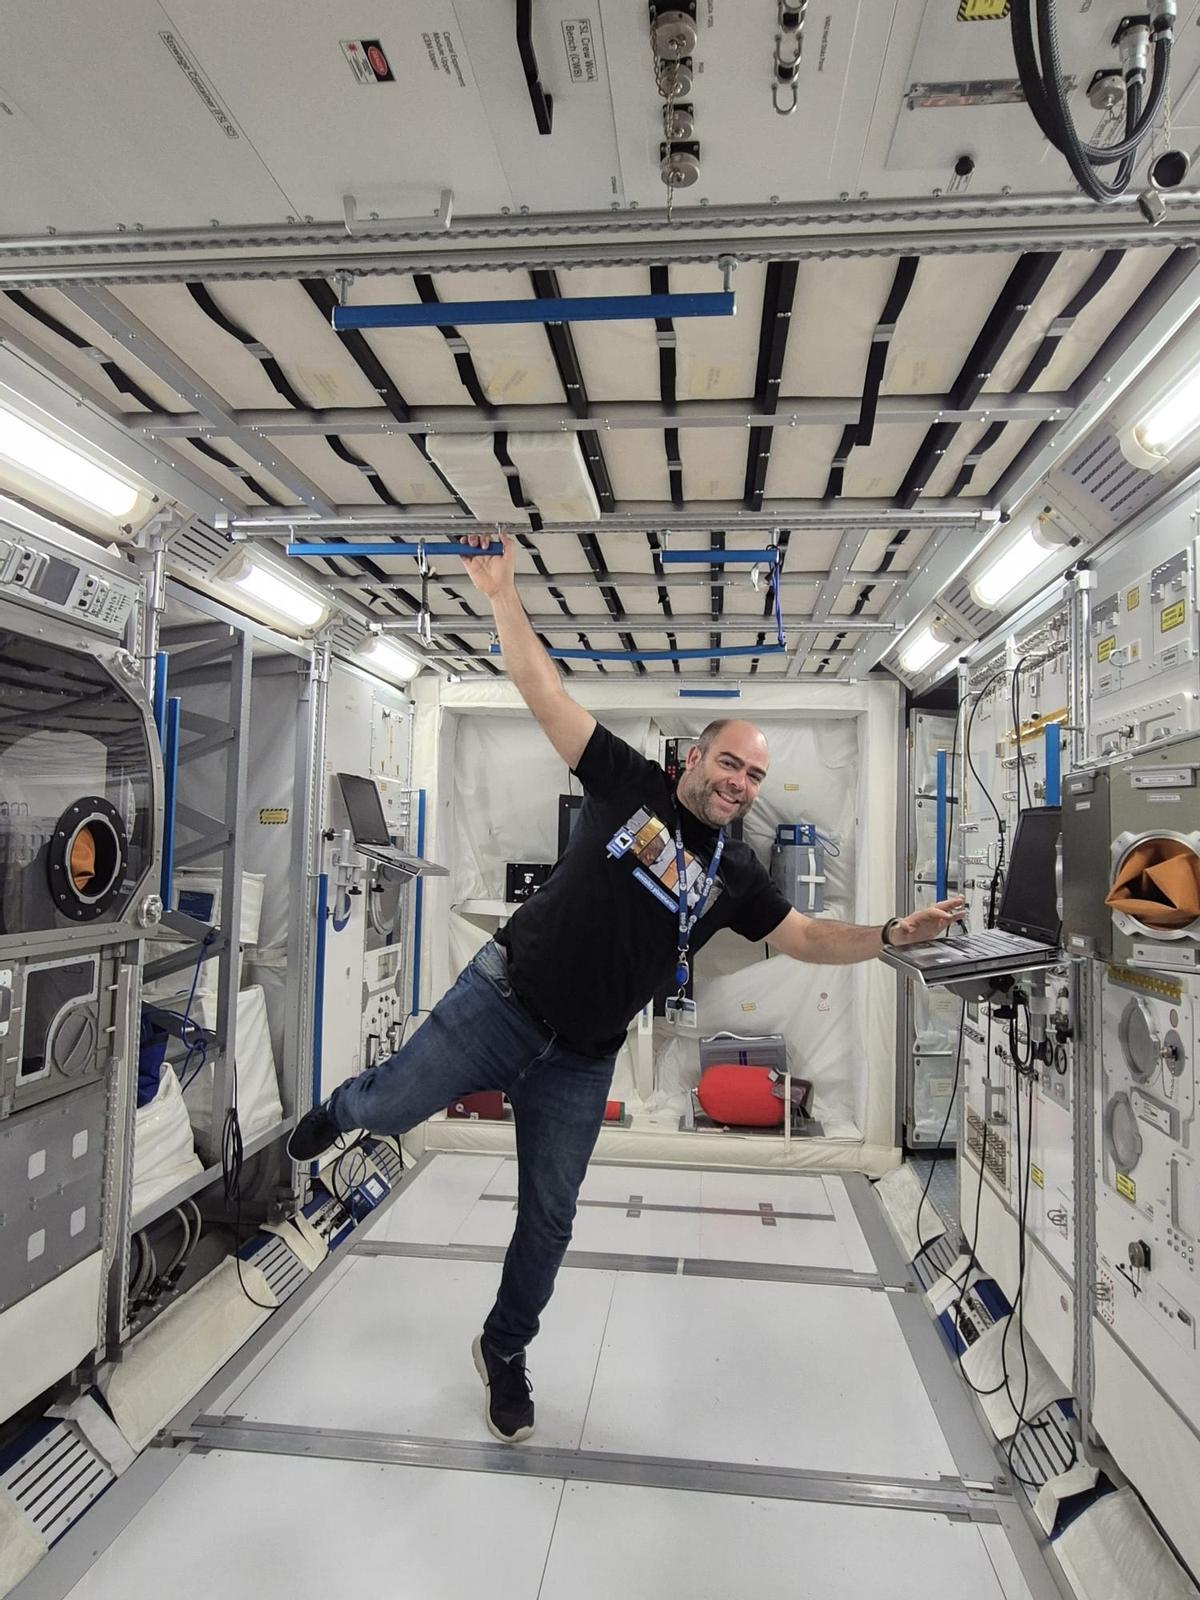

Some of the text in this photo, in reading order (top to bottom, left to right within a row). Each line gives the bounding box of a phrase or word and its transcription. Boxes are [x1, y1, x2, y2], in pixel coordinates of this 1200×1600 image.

[565, 25, 583, 77] Bench (CWB)
[578, 20, 595, 81] FSL Crew Work
